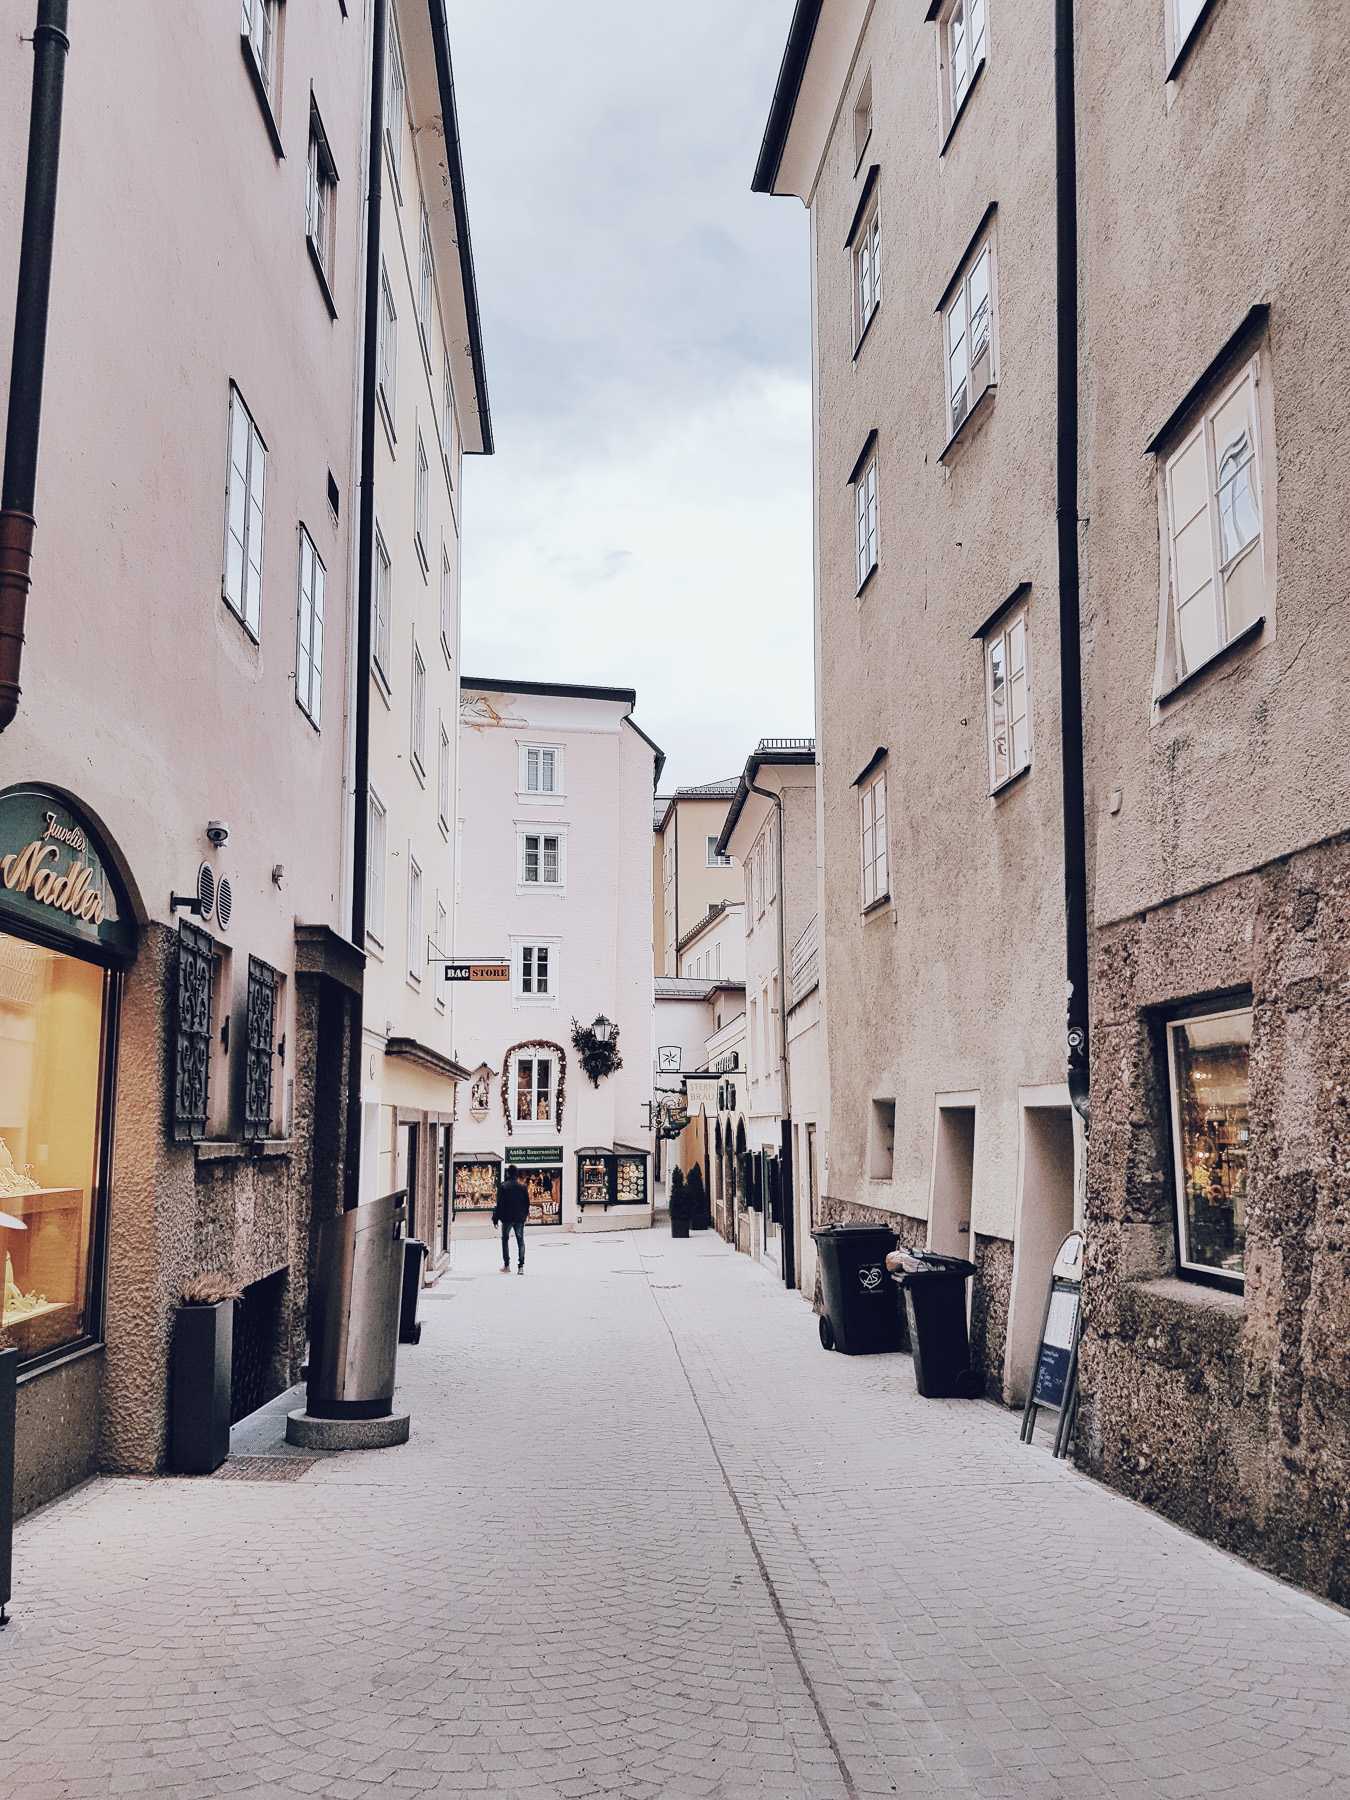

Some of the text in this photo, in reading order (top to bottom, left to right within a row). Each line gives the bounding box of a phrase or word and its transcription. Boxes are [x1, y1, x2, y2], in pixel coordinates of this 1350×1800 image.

[43, 811, 87, 853] Juwelier
[0, 841, 105, 925] Nadler
[447, 968, 507, 978] BAG STORE
